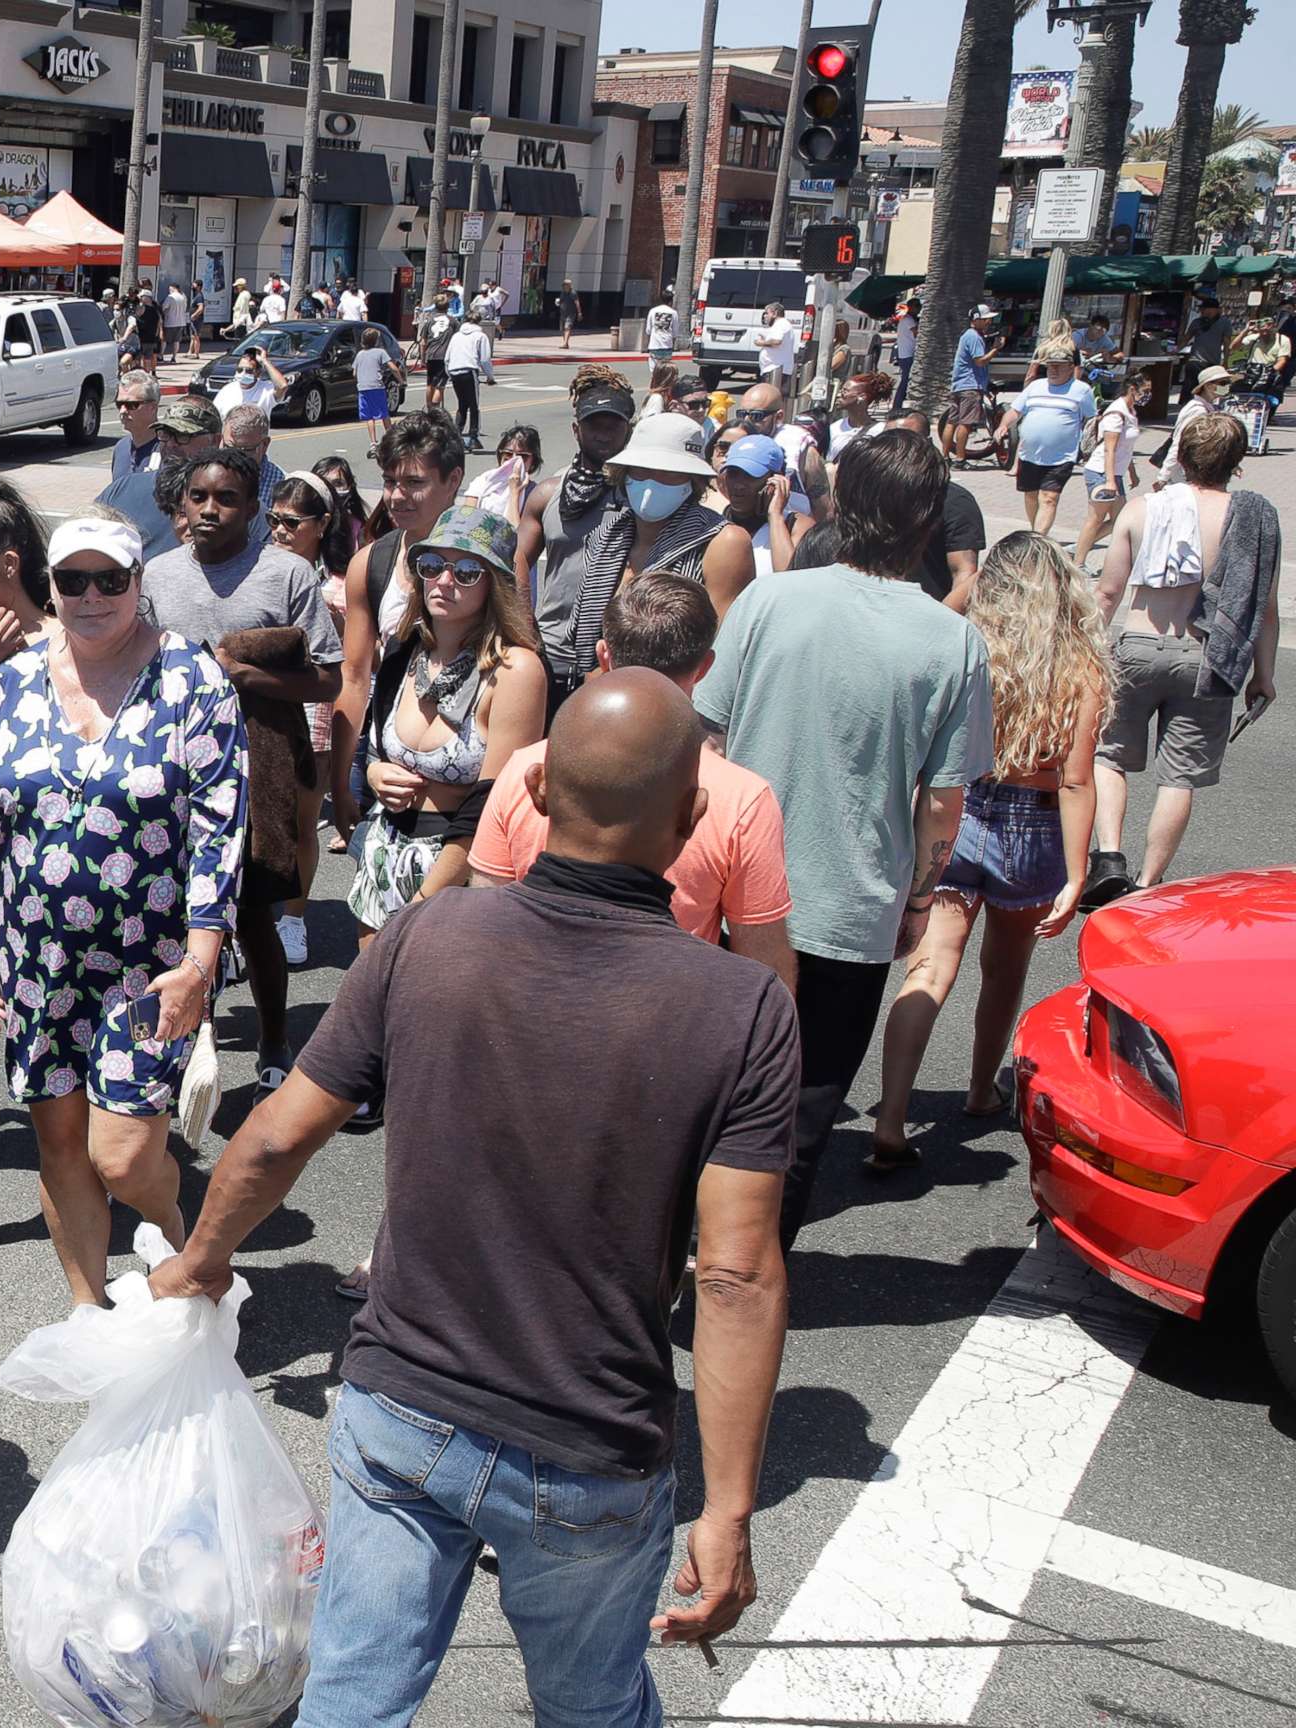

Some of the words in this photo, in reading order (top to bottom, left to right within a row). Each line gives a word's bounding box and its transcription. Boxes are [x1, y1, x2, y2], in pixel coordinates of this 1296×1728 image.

[47, 46, 101, 79] JACK'S
[1022, 86, 1061, 99] WORLD
[174, 99, 265, 135] BILLABONG
[5, 152, 39, 166] DRAGON
[517, 137, 567, 170] RVCA
[837, 235, 855, 264] 16
